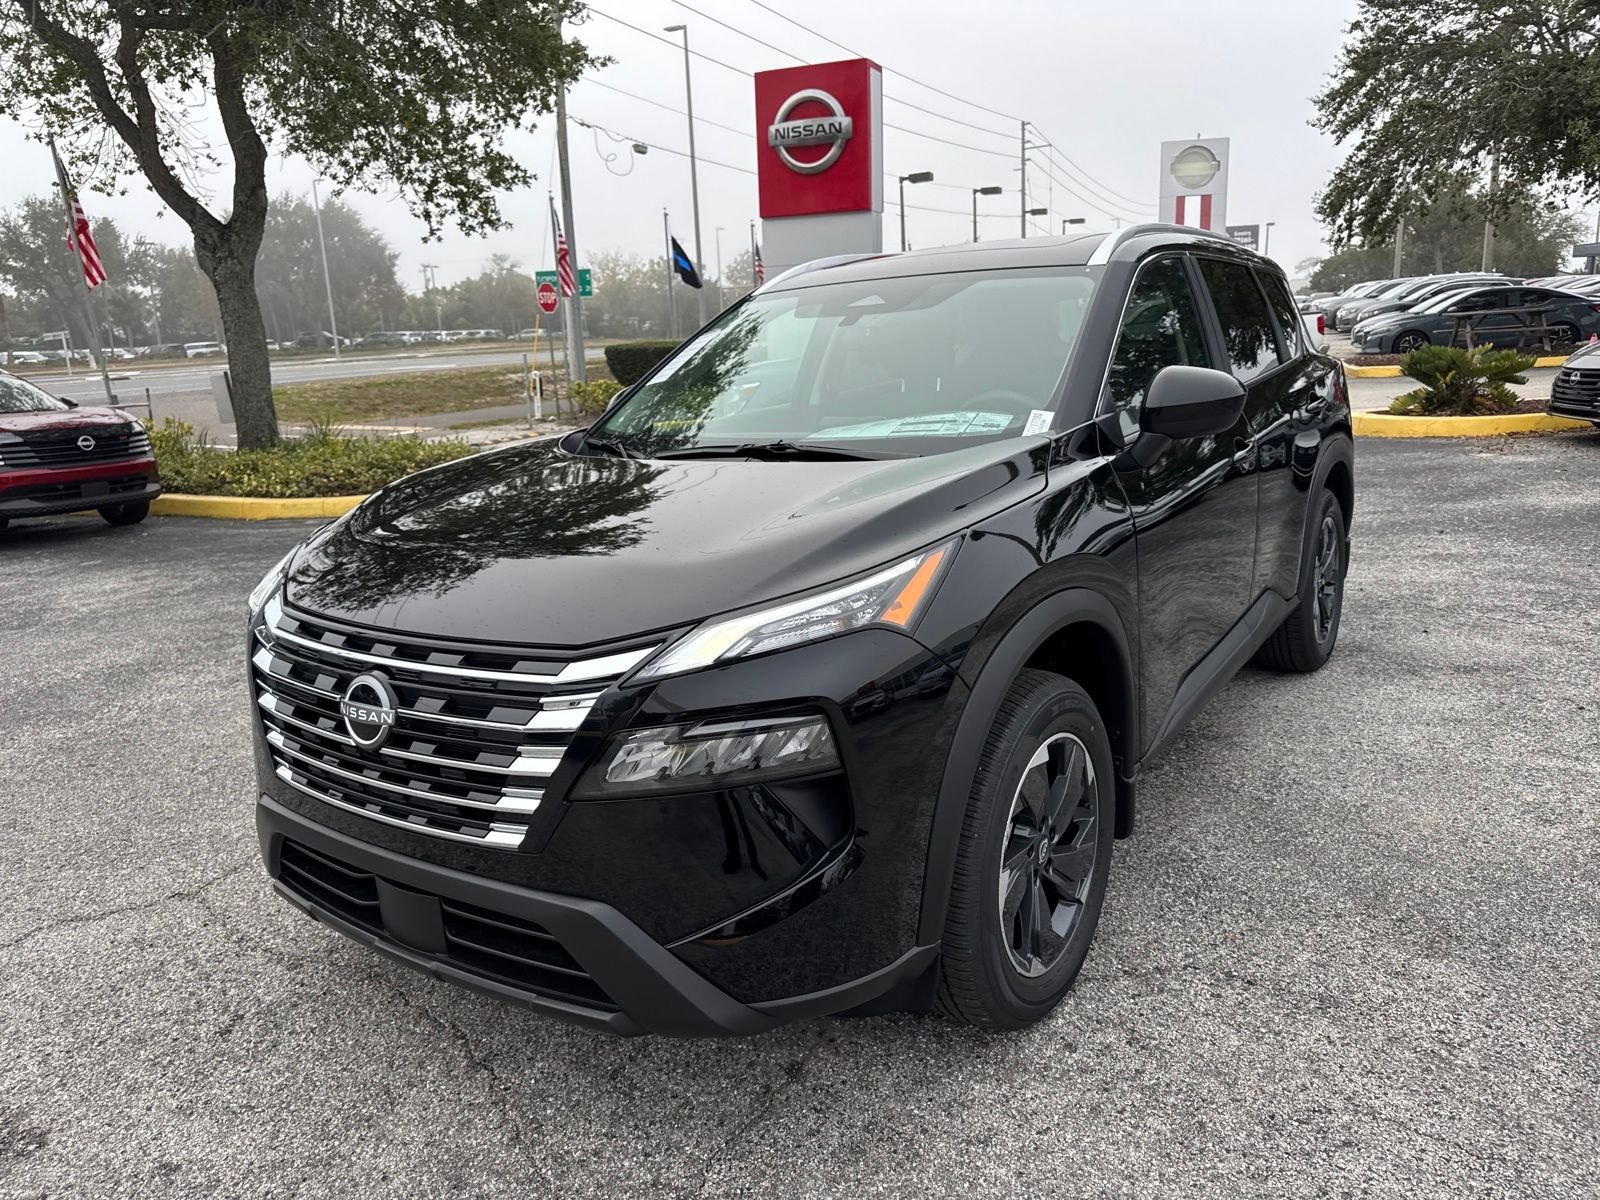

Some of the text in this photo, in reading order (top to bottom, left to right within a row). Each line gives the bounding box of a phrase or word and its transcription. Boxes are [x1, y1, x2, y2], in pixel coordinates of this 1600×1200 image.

[774, 121, 843, 141] NISSAN
[539, 292, 556, 304] STOP
[340, 702, 393, 724] NISSAN
